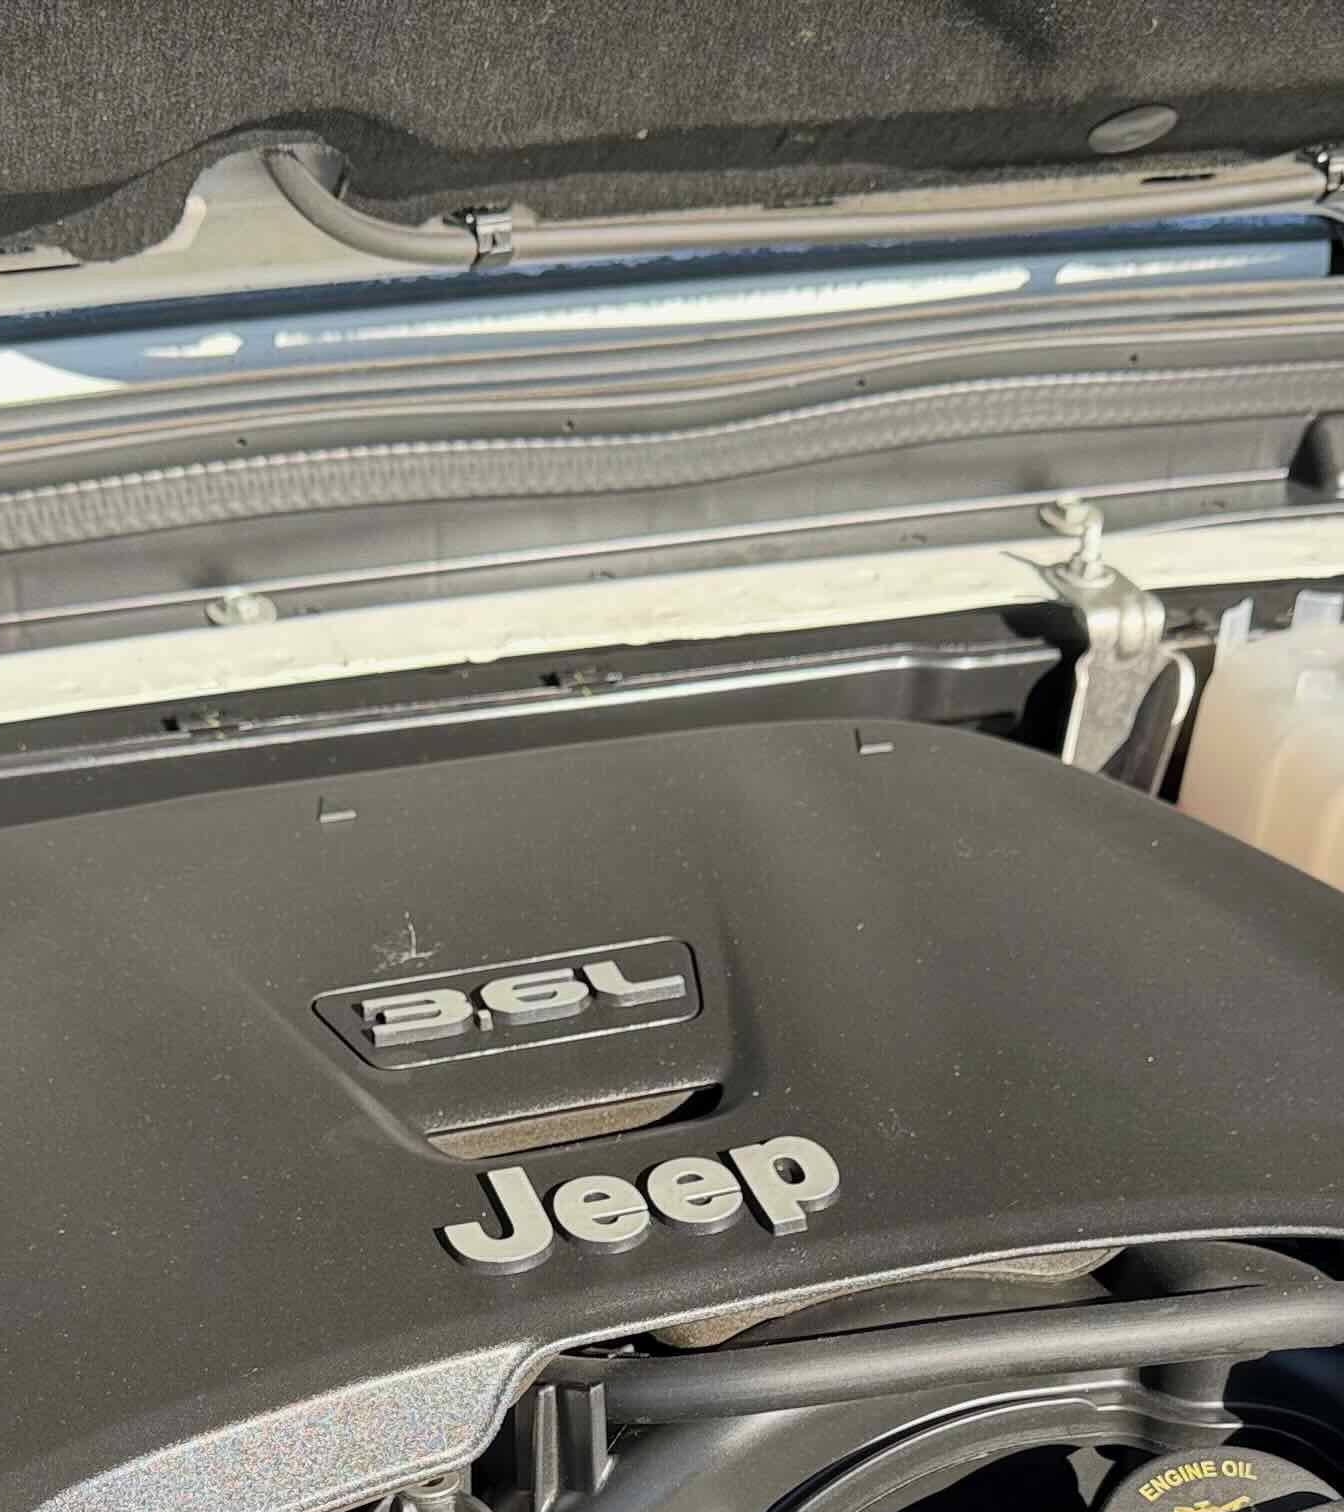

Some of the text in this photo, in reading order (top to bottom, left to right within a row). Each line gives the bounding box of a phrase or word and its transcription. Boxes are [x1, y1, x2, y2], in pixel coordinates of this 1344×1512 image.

[360, 959, 686, 1048] 3.6L
[442, 1135, 842, 1276] Jeep
[1138, 1459, 1258, 1503] ENGINE OIL
